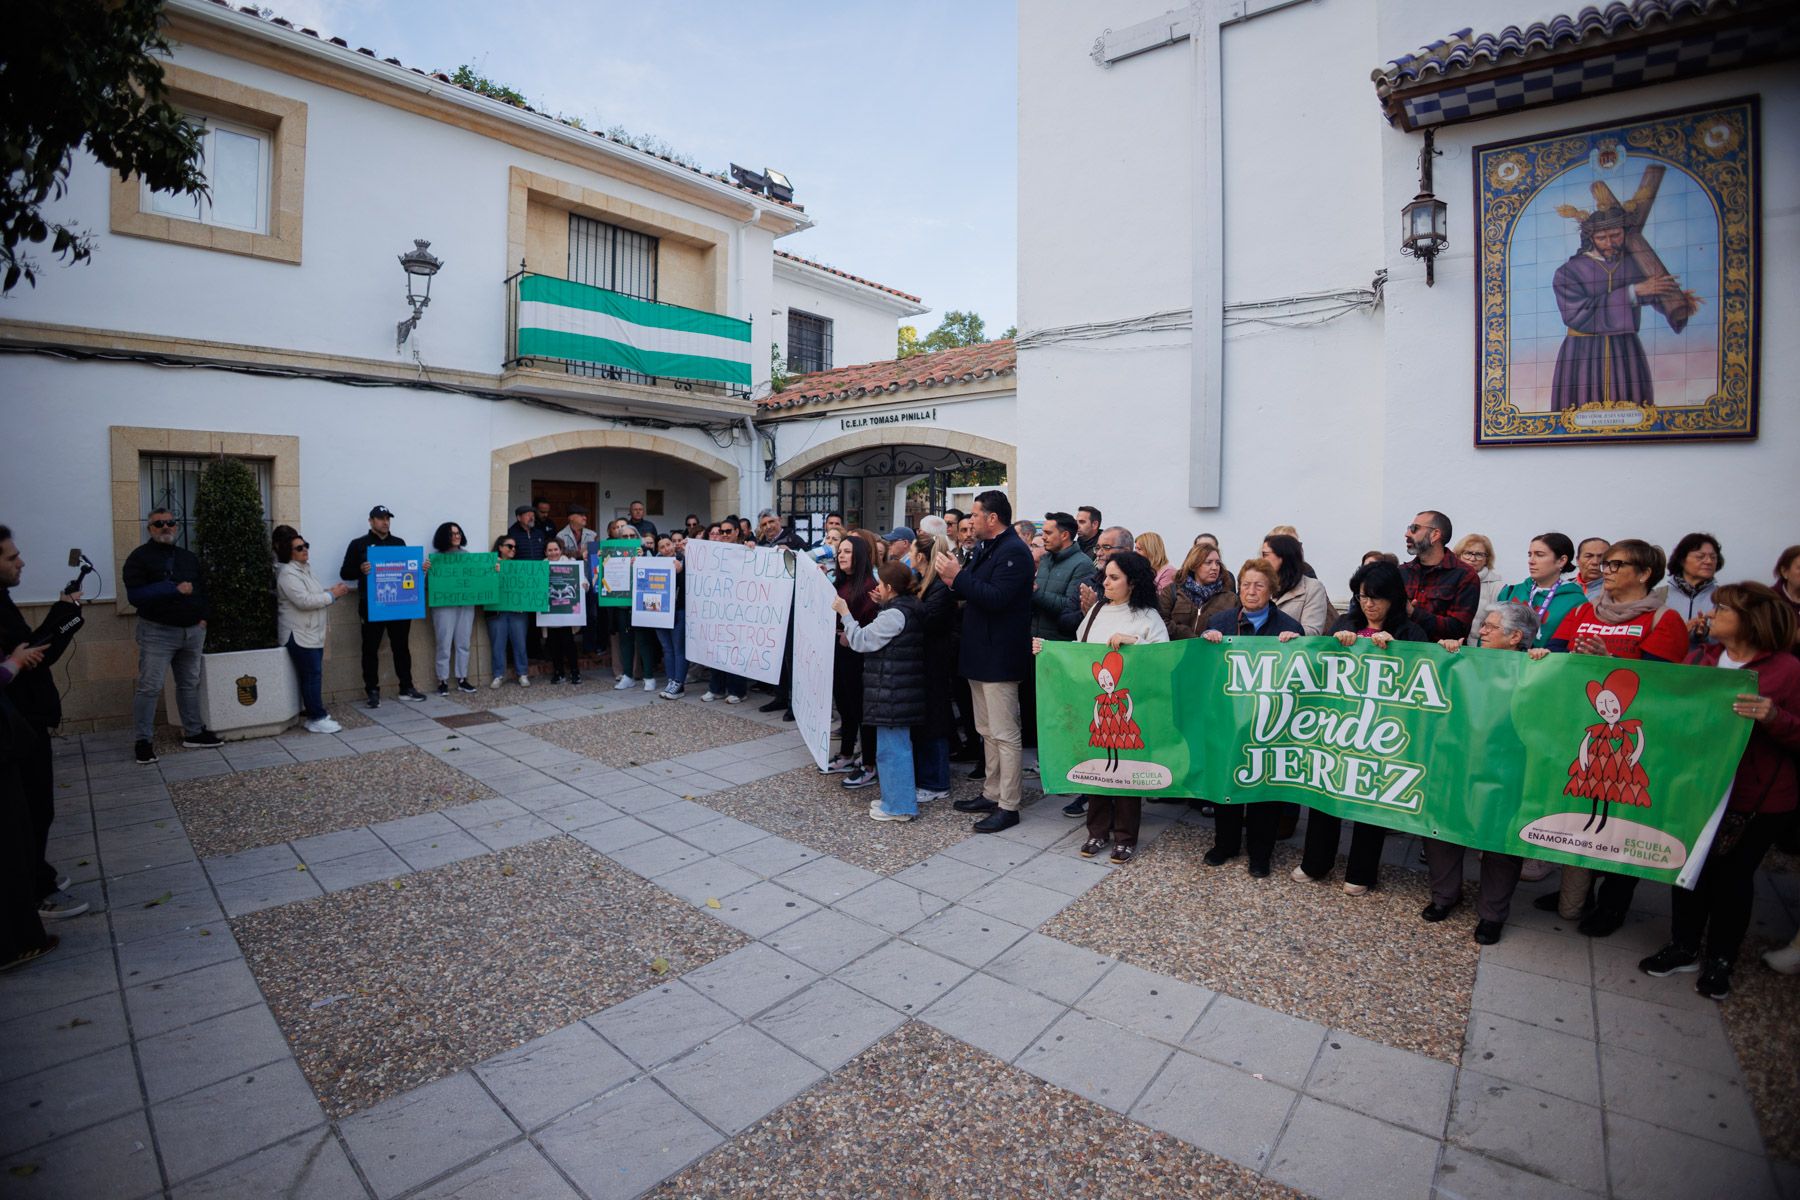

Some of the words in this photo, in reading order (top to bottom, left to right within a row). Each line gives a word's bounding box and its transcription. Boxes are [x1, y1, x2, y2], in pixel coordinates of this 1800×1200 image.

[845, 418, 868, 428] C.E.I.P.
[870, 414, 899, 425] TOMASA
[901, 410, 930, 421] PINILLA
[686, 545, 706, 571] NO
[711, 546, 732, 574] SE
[455, 578, 471, 588] SE
[685, 573, 735, 599] JUGAR
[735, 580, 772, 603] CON
[701, 600, 783, 624] EDUCACION
[700, 623, 776, 648] NUESTROS
[1576, 622, 1629, 636] CCOO
[706, 645, 771, 672] HIJOS/AS
[1226, 654, 1447, 708] MAREA
[1254, 692, 1407, 754] Verde
[1237, 746, 1423, 810] JEREZ
[1527, 831, 1593, 849] ENAMORAD@S
[1595, 843, 1608, 852] de
[1610, 845, 1620, 854] la
[1624, 838, 1672, 855] ESCUELA
